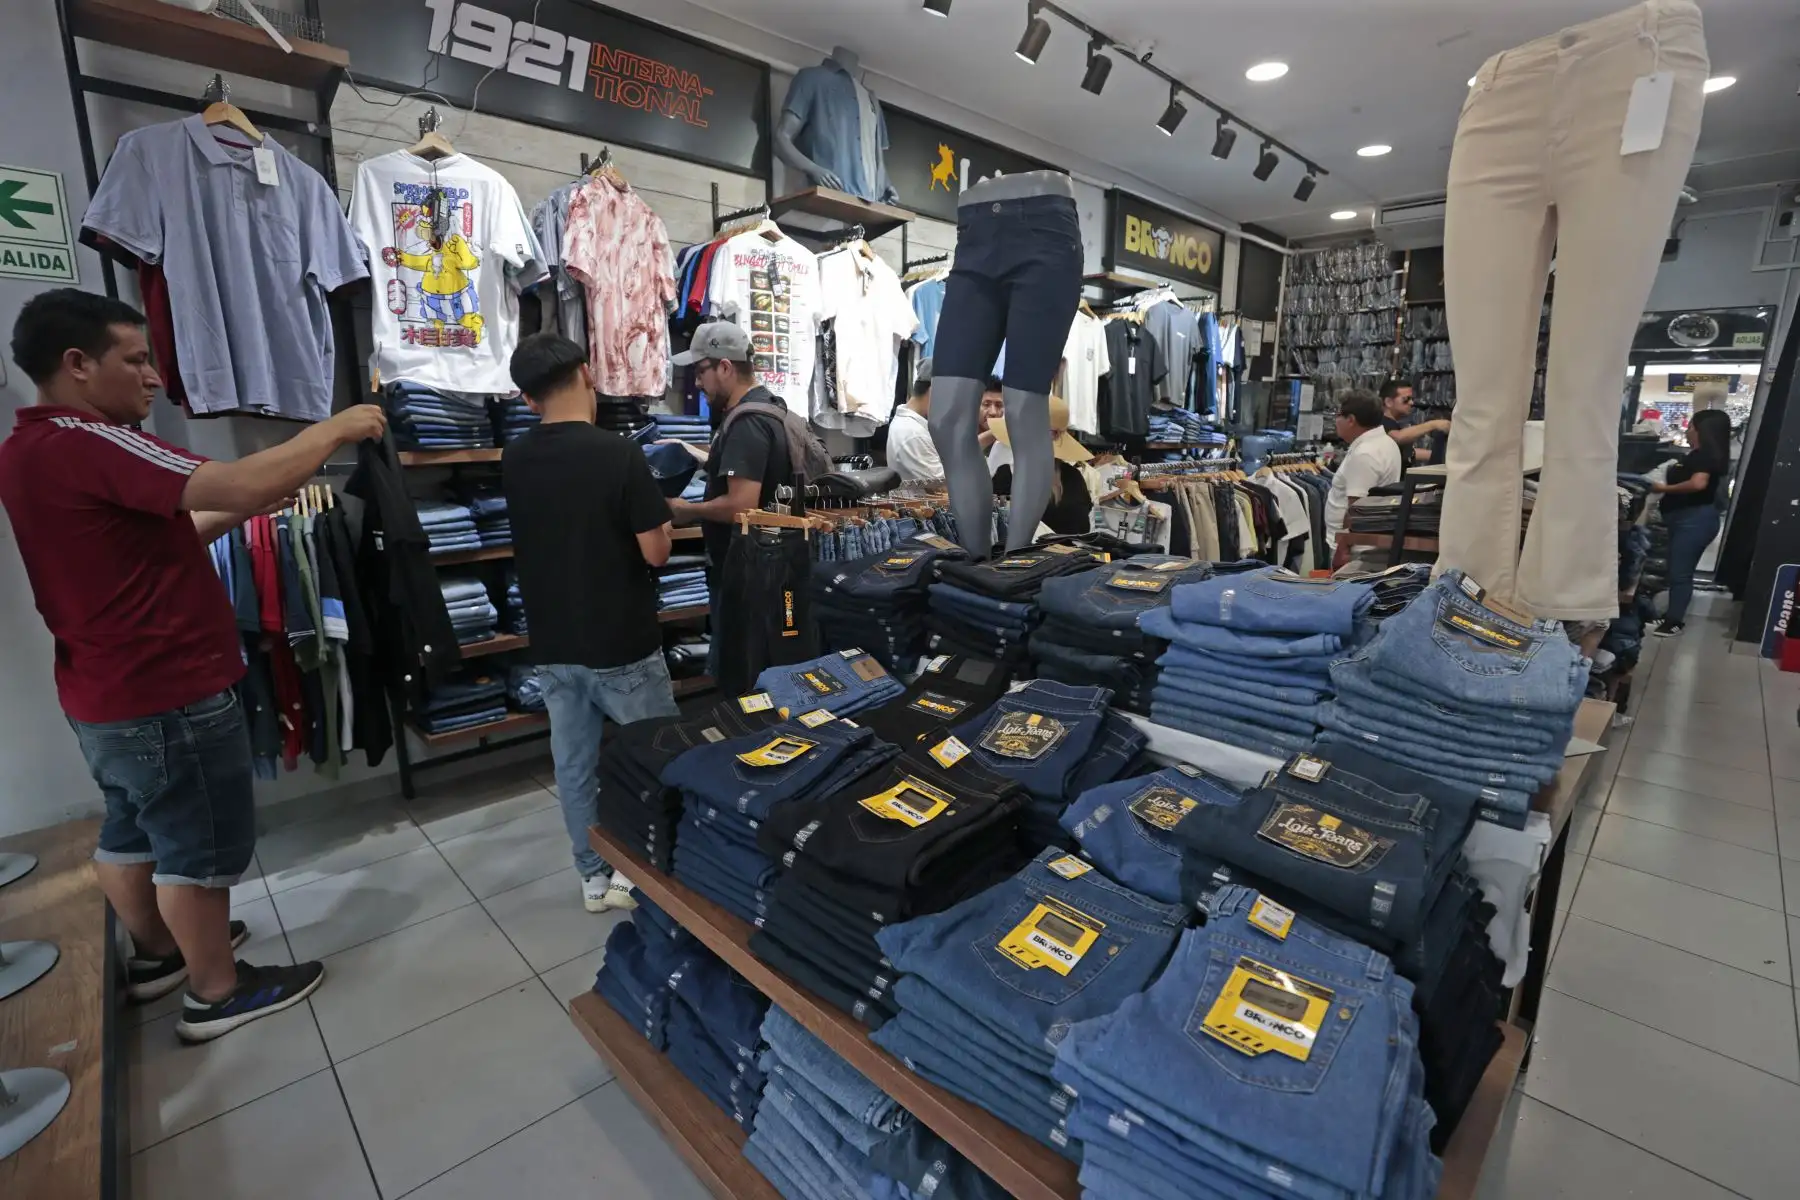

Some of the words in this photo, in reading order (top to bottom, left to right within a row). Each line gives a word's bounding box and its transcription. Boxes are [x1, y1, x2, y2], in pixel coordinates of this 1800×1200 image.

[425, 0, 592, 92] 1921
[591, 42, 714, 97] INTERNA-
[589, 68, 708, 127] TIONAL
[0, 249, 67, 271] ALIDA
